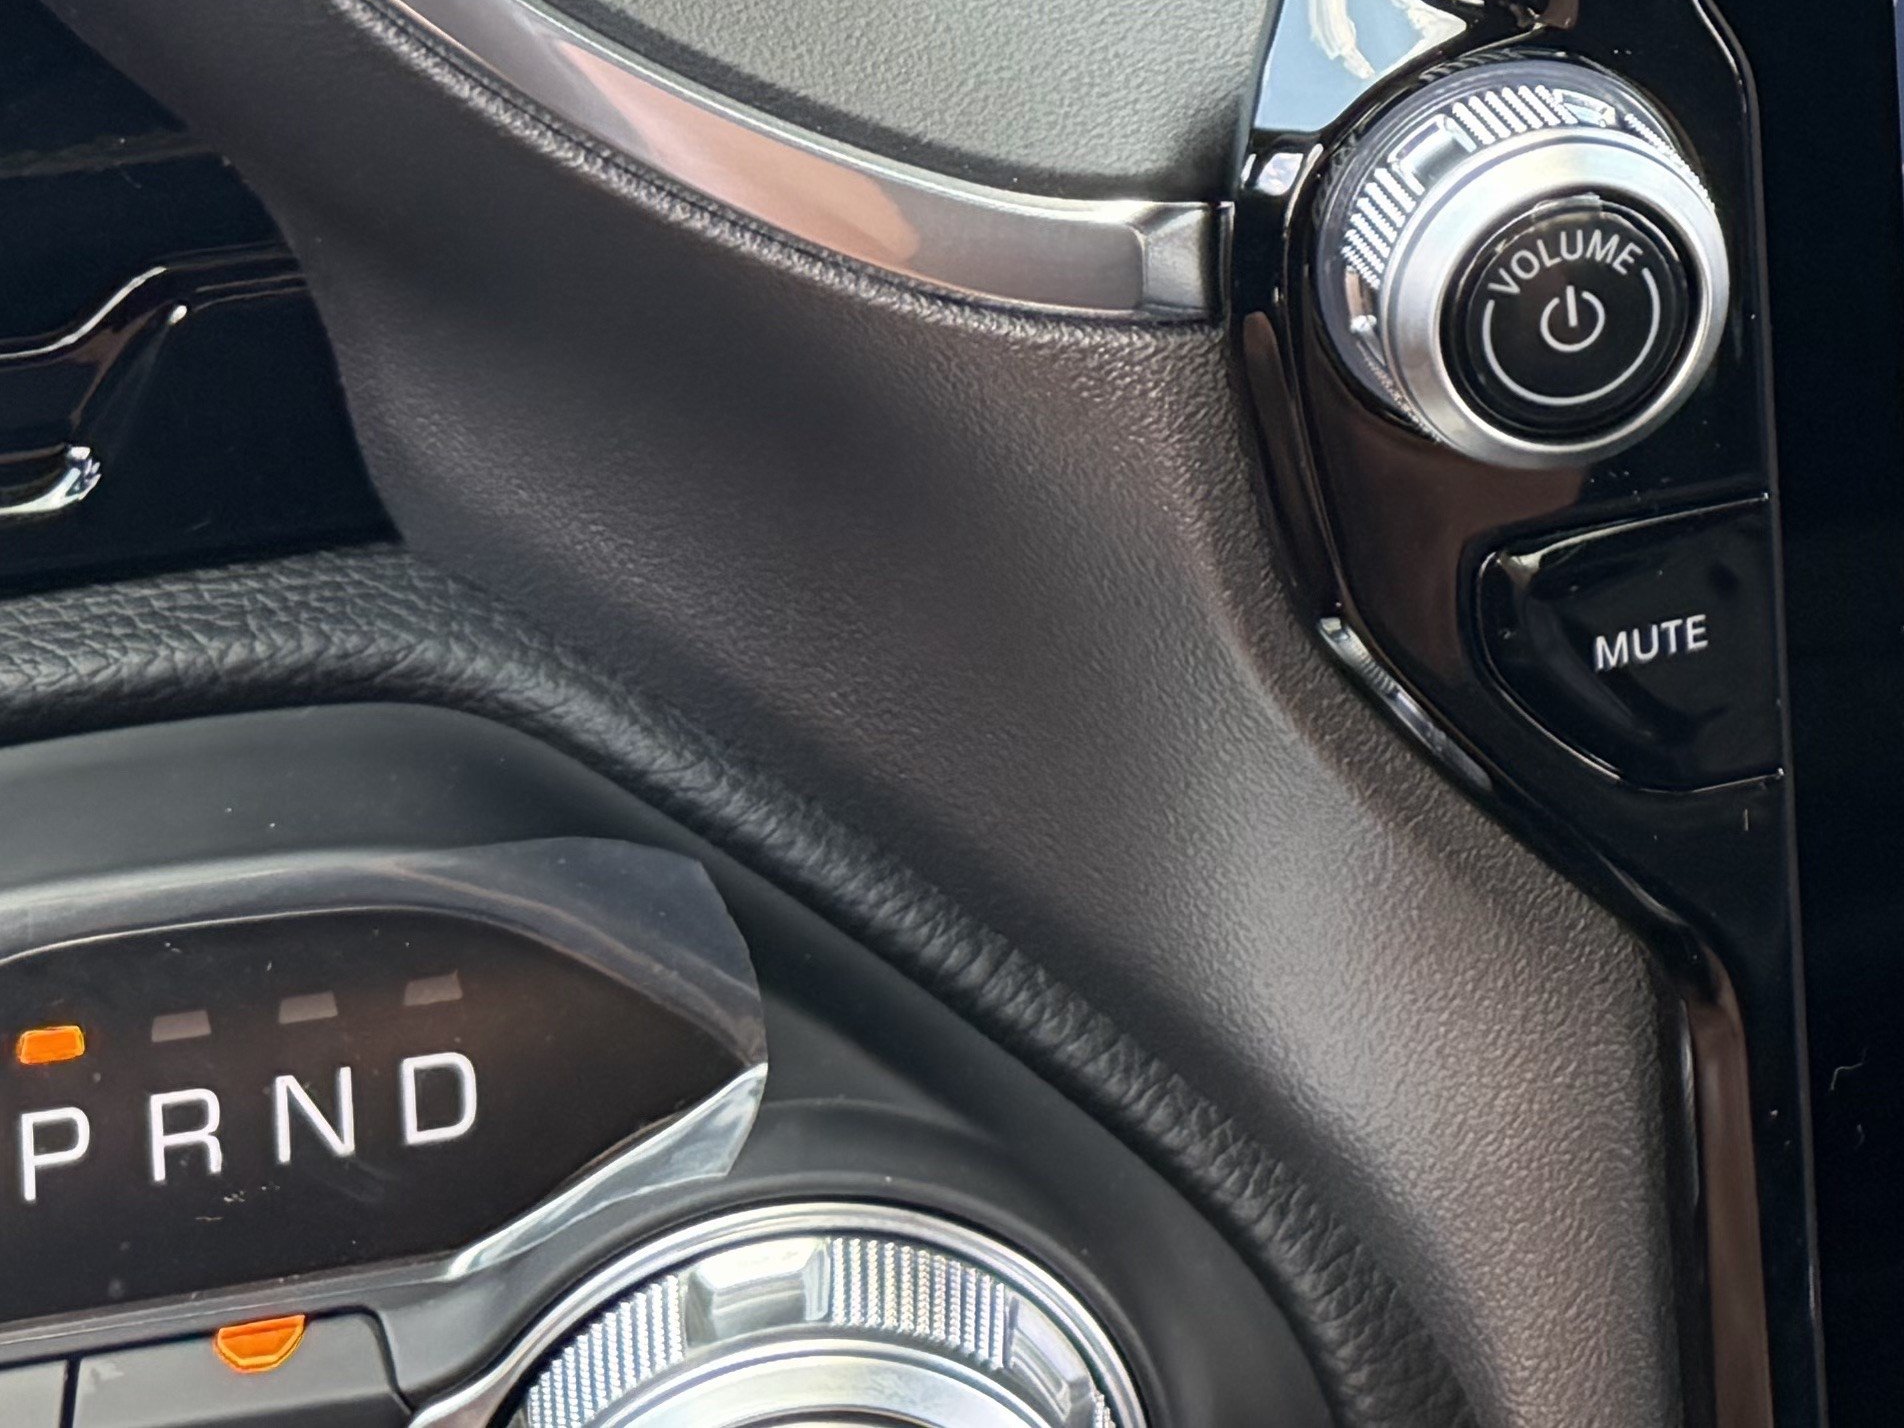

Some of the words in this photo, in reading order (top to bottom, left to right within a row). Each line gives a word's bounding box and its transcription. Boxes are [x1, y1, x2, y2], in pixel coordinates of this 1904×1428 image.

[1488, 230, 1645, 298] VOLUME
[1595, 614, 1708, 672] MUTE
[20, 1106, 91, 1202] P
[150, 1088, 223, 1182] R
[273, 1066, 356, 1163] N
[401, 1051, 479, 1145] D
